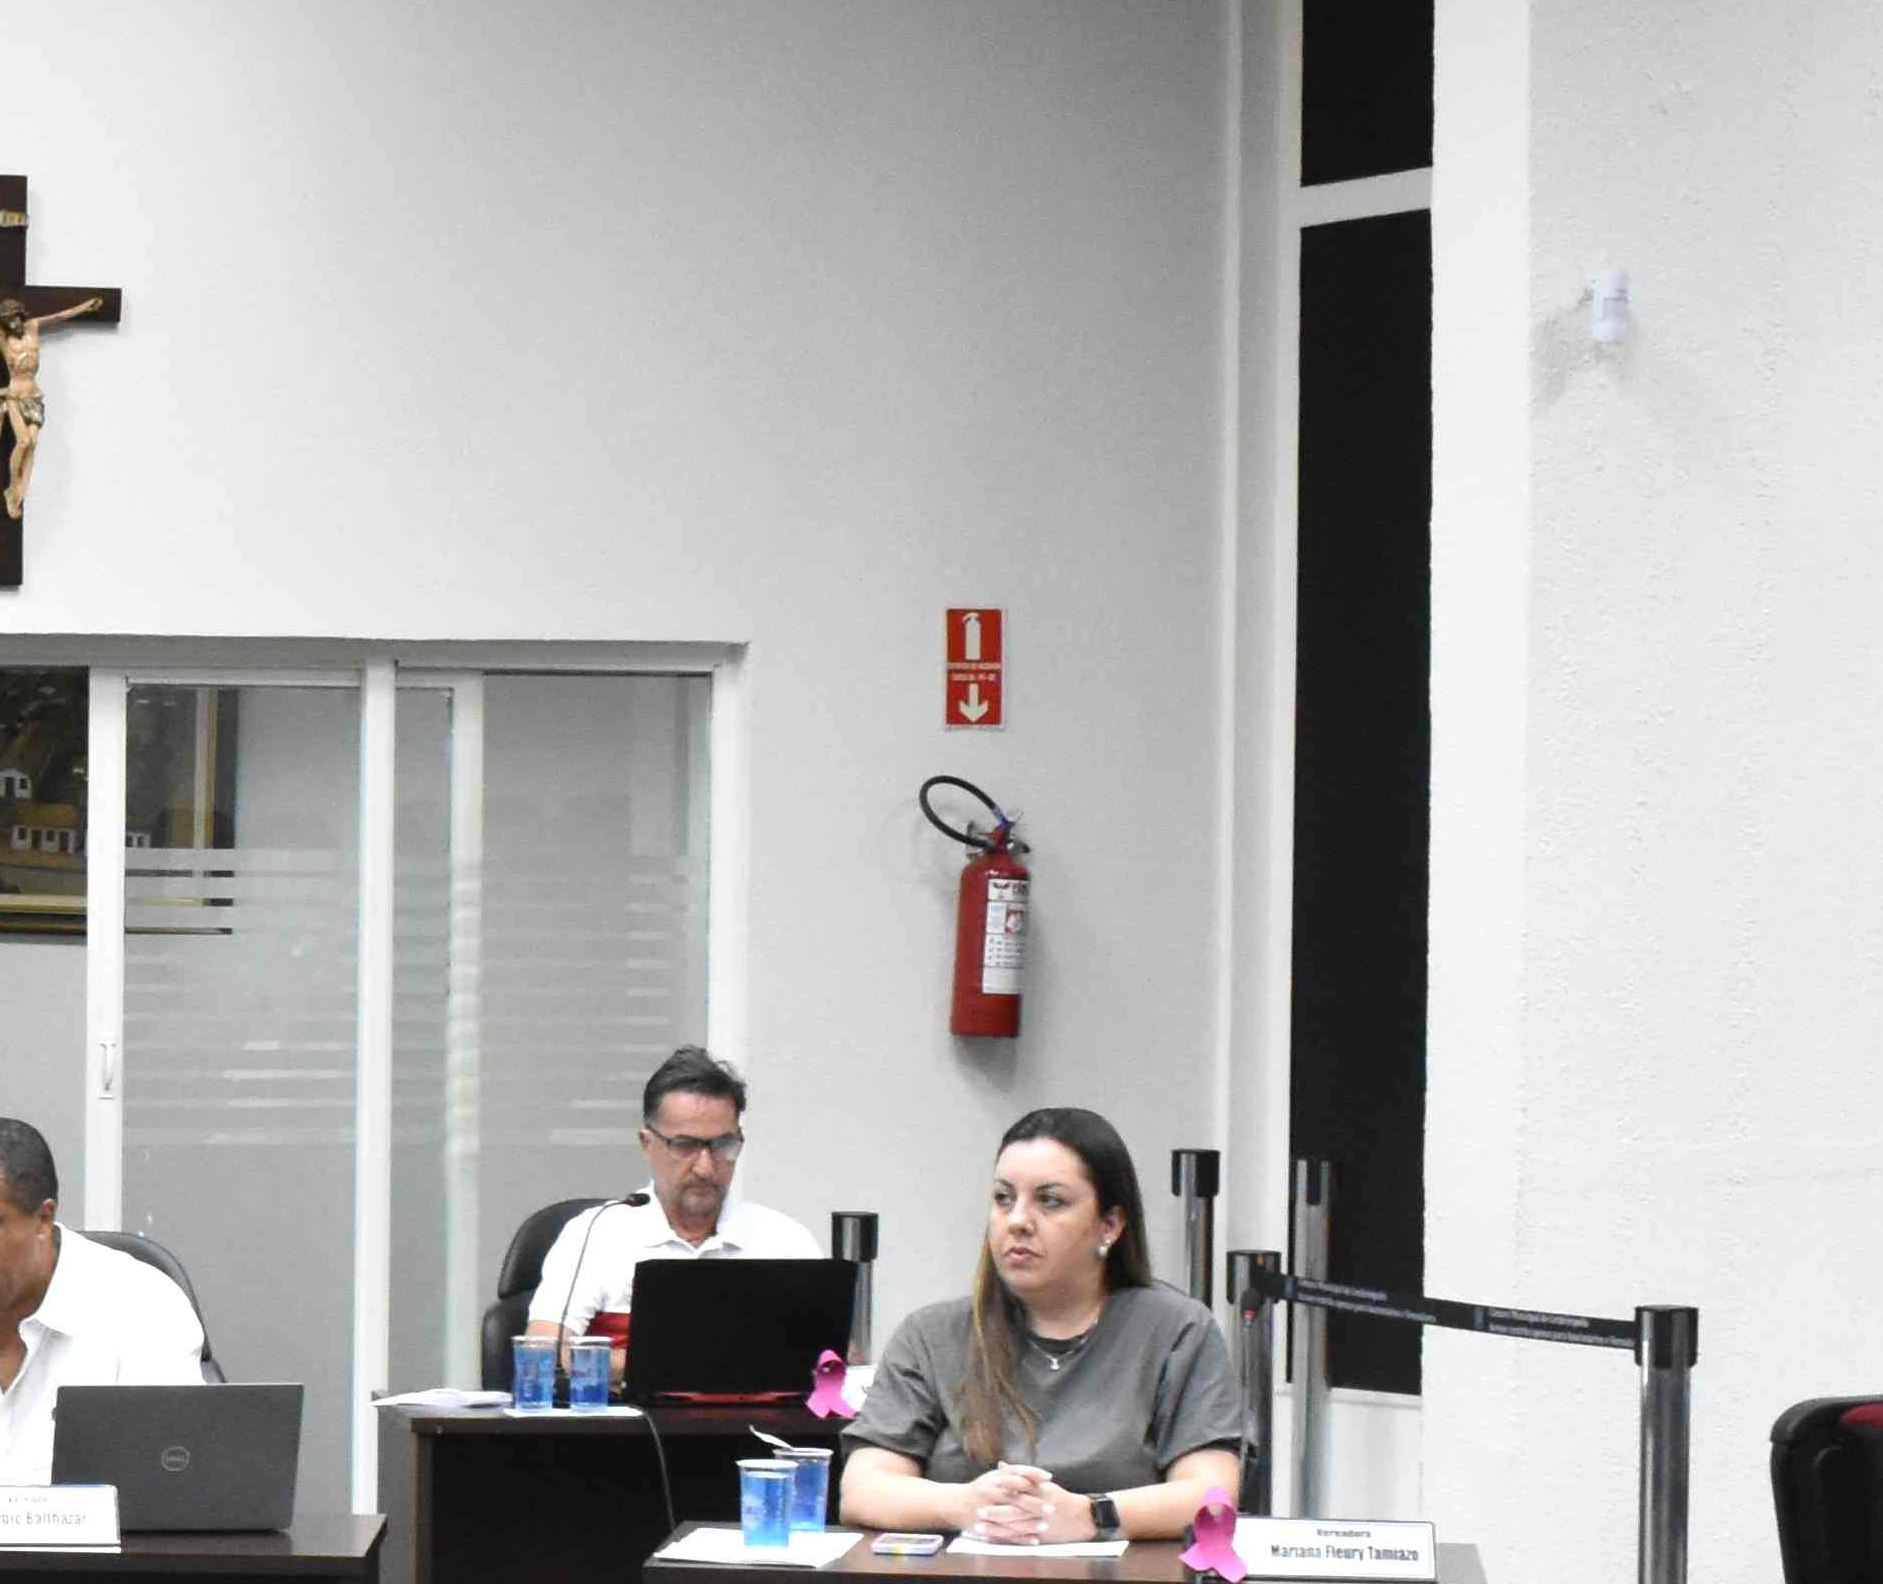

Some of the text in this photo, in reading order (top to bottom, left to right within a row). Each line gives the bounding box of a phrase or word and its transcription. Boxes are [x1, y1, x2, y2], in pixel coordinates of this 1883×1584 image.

[1317, 1528, 1371, 1538] Vereadora
[1271, 1545, 1321, 1559] Mariana
[1325, 1545, 1364, 1562] Fleury
